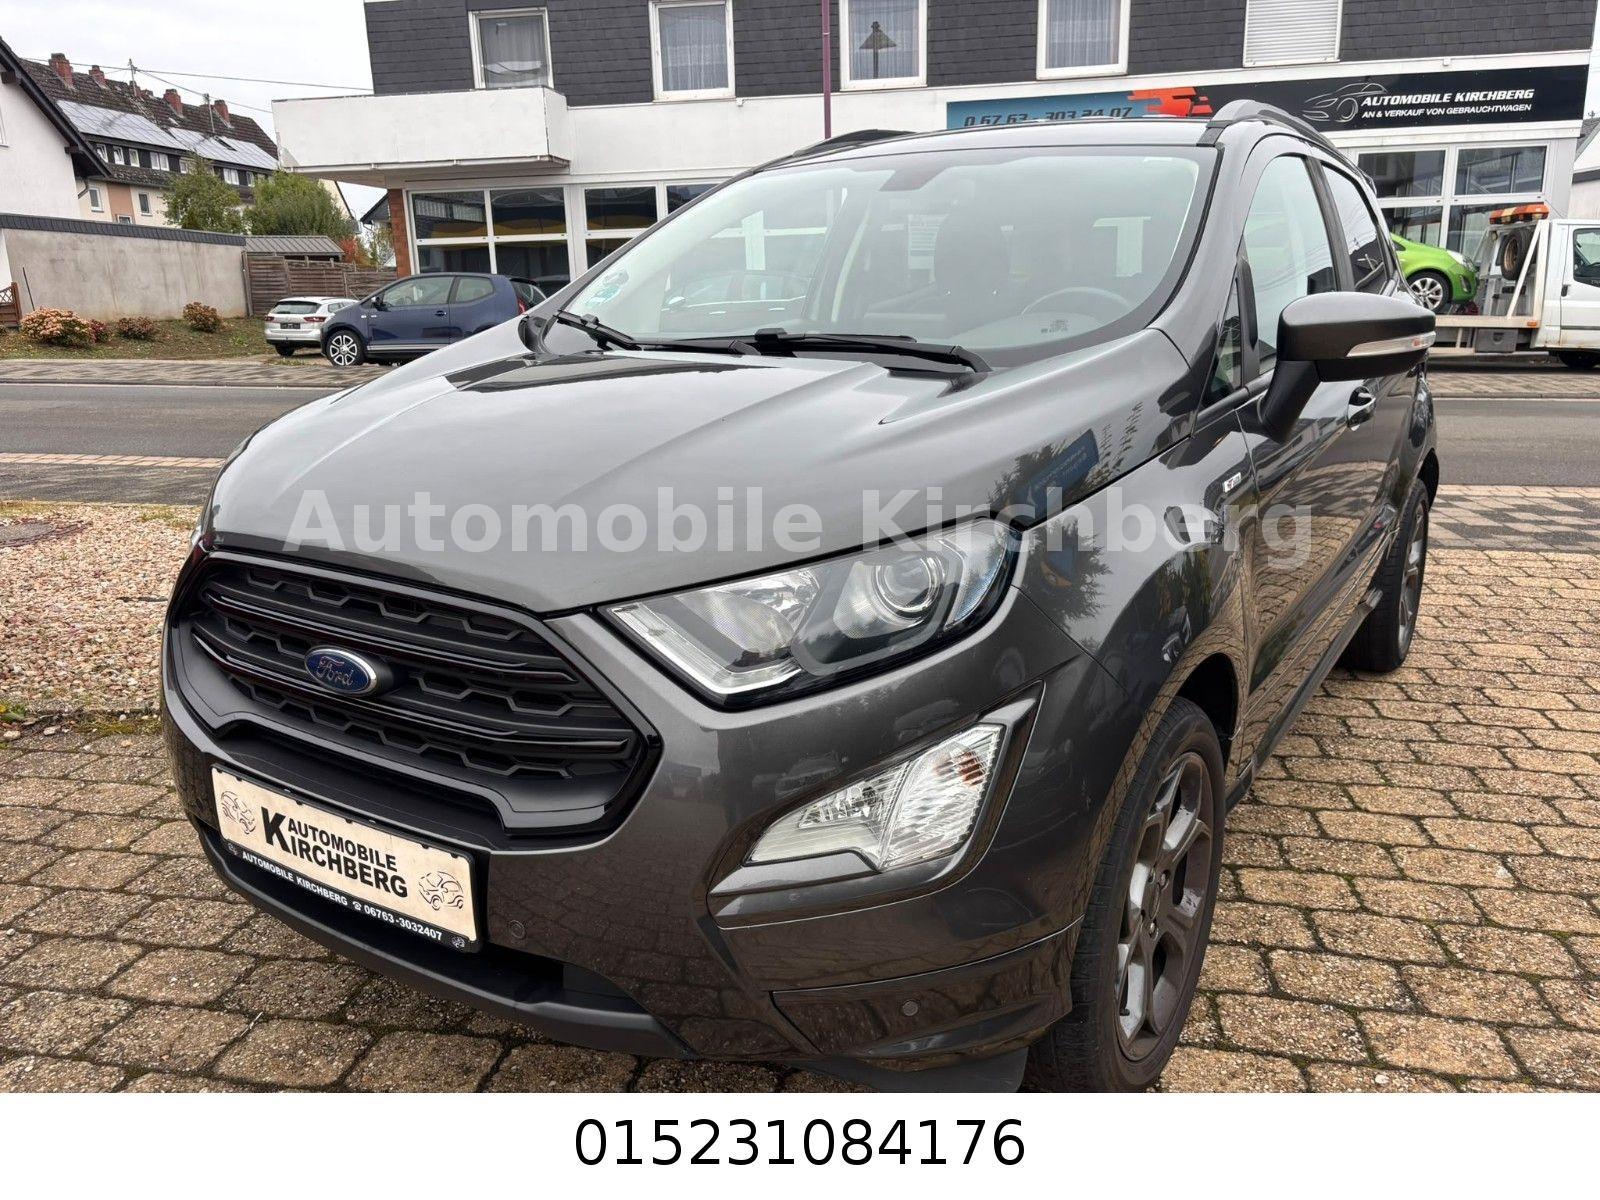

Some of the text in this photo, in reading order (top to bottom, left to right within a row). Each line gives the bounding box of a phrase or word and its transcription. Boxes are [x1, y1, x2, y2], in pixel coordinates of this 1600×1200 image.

[1361, 89, 1535, 107] AUTOMOBILE KIRCHBERG
[1362, 111, 1375, 119] AN
[1384, 109, 1425, 118] VERKAUF
[1426, 108, 1445, 116] VON
[1446, 104, 1532, 115] GEBRAUCHTWAGEN
[316, 655, 355, 686] Ford
[261, 806, 408, 898] KIRCHBERG
[287, 818, 398, 873] AUTOMOBILE
[242, 851, 443, 941] AUTOMOBILE KIRCHBERG 06763-3032407
